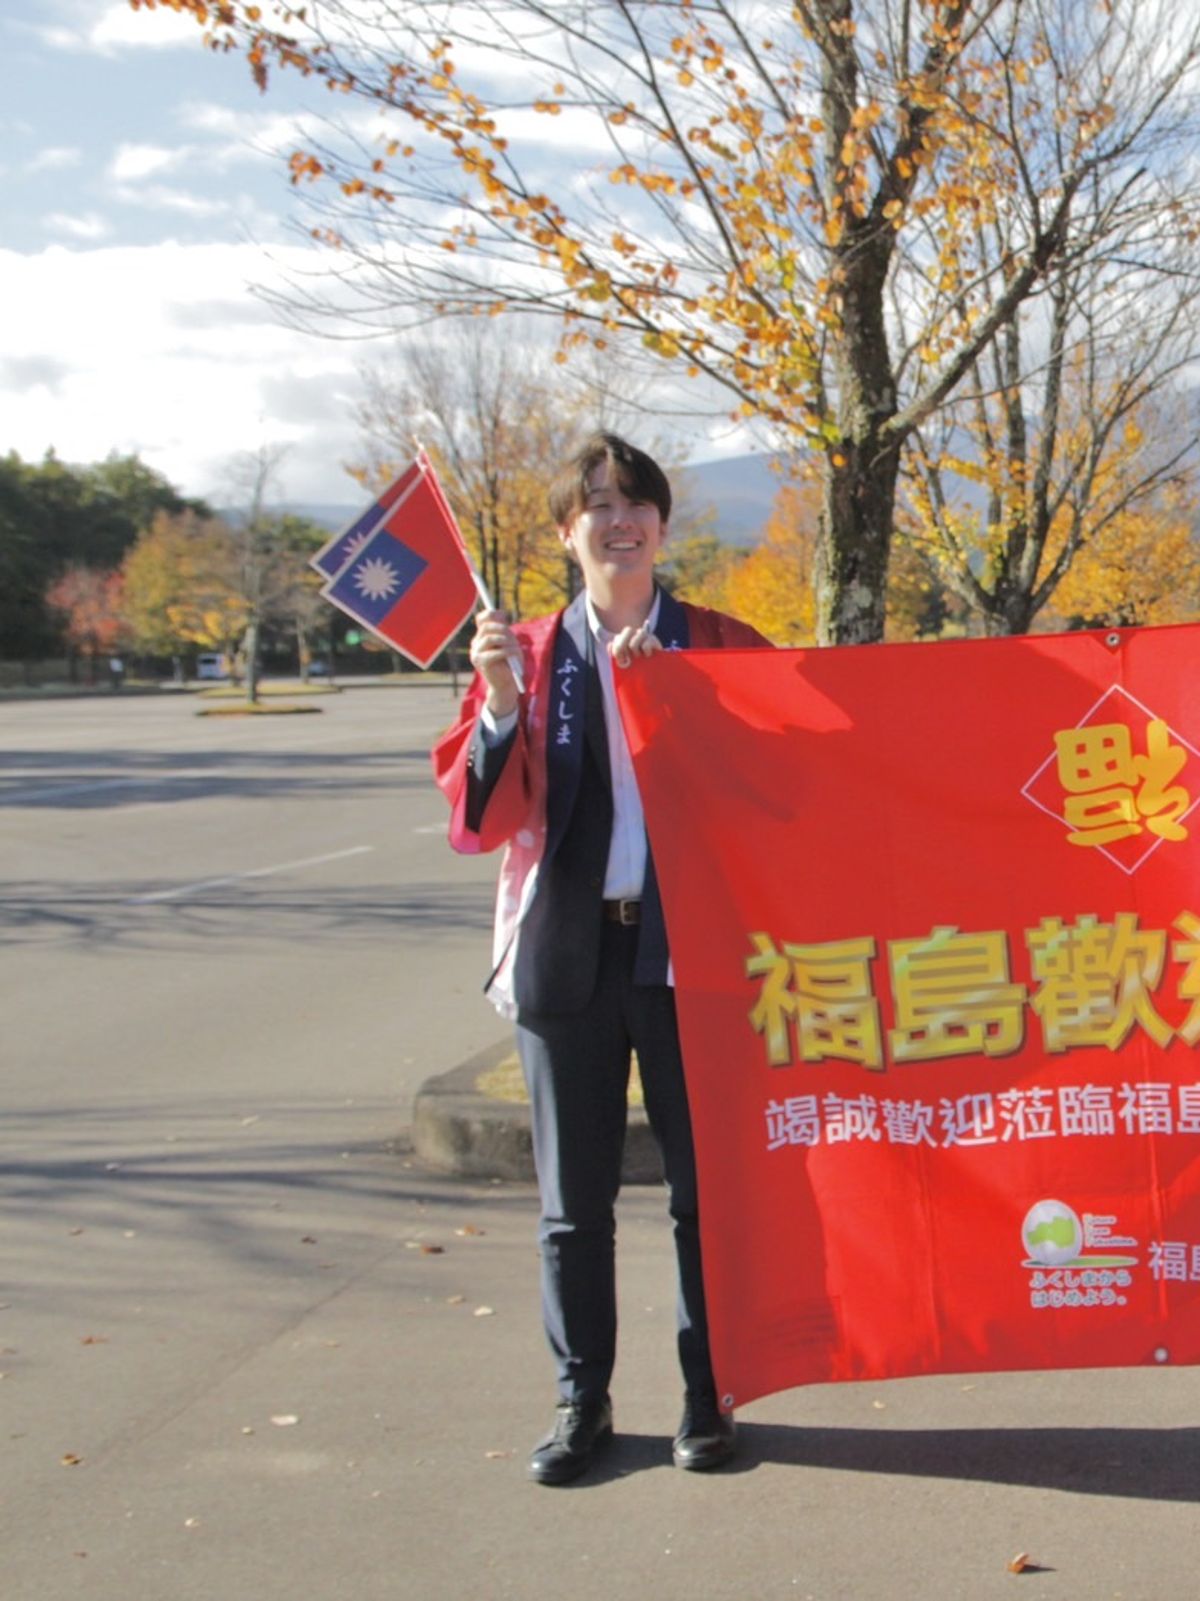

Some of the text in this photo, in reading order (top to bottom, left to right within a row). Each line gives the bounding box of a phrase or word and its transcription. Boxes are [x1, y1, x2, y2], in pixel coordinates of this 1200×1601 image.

[556, 658, 579, 744] ふくしま
[1054, 719, 1189, 846] 福
